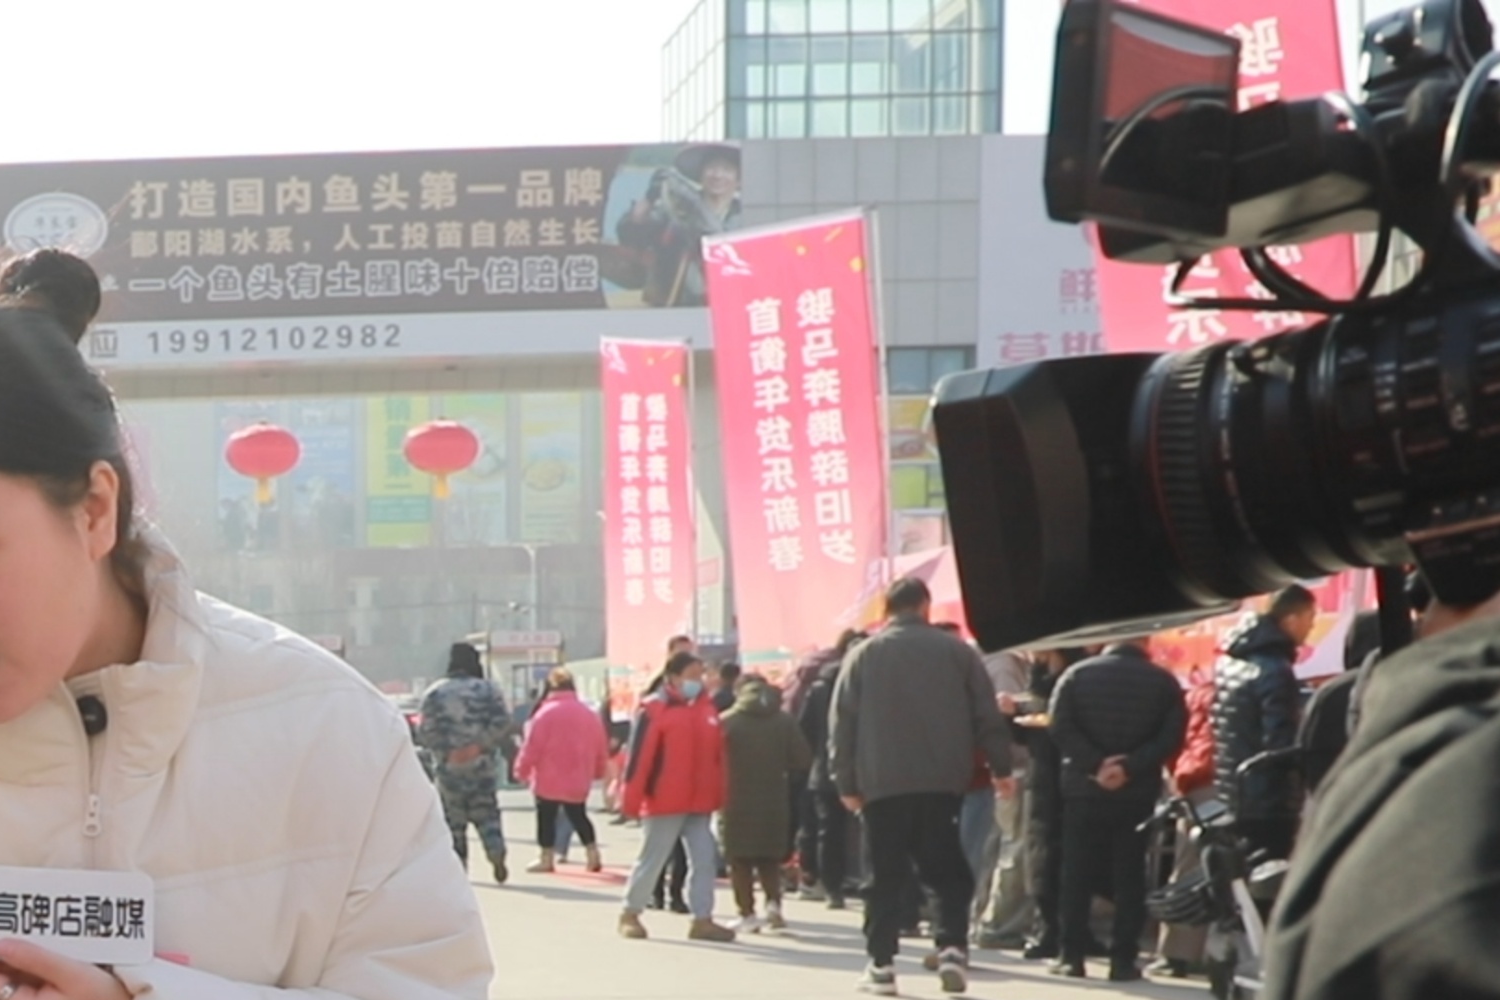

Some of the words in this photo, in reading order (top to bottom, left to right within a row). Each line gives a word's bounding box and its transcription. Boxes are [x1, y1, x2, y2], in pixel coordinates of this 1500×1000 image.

[130, 168, 603, 220] 打造国内鱼头第一品牌
[128, 253, 599, 303] 一个鱼头有土腥味十倍赔偿
[147, 323, 400, 354] 19912102982
